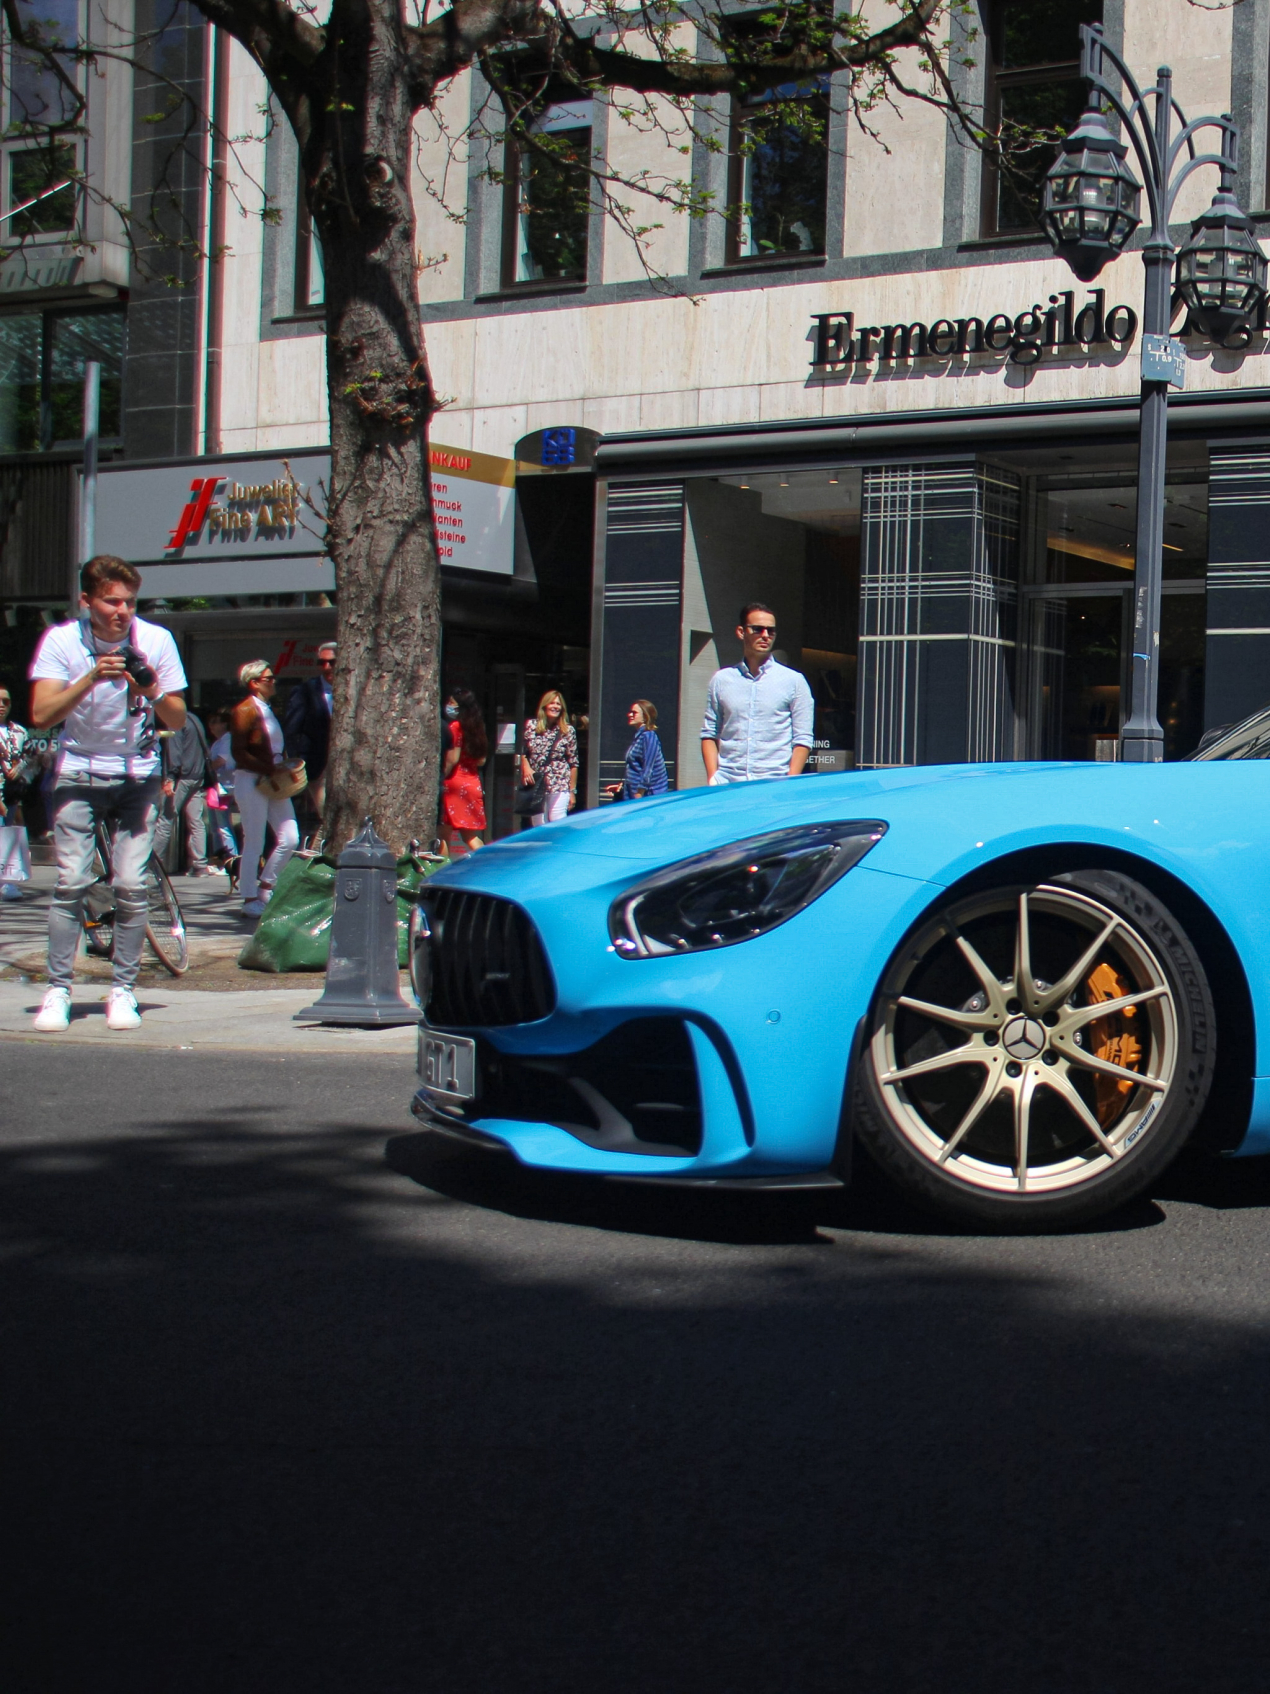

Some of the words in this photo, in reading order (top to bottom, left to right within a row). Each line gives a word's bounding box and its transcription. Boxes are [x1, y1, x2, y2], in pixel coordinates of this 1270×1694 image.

[809, 288, 1138, 366] Ermenegildo
[228, 478, 301, 501] Juwelier
[209, 507, 253, 530] Fine
[256, 500, 301, 527] ART
